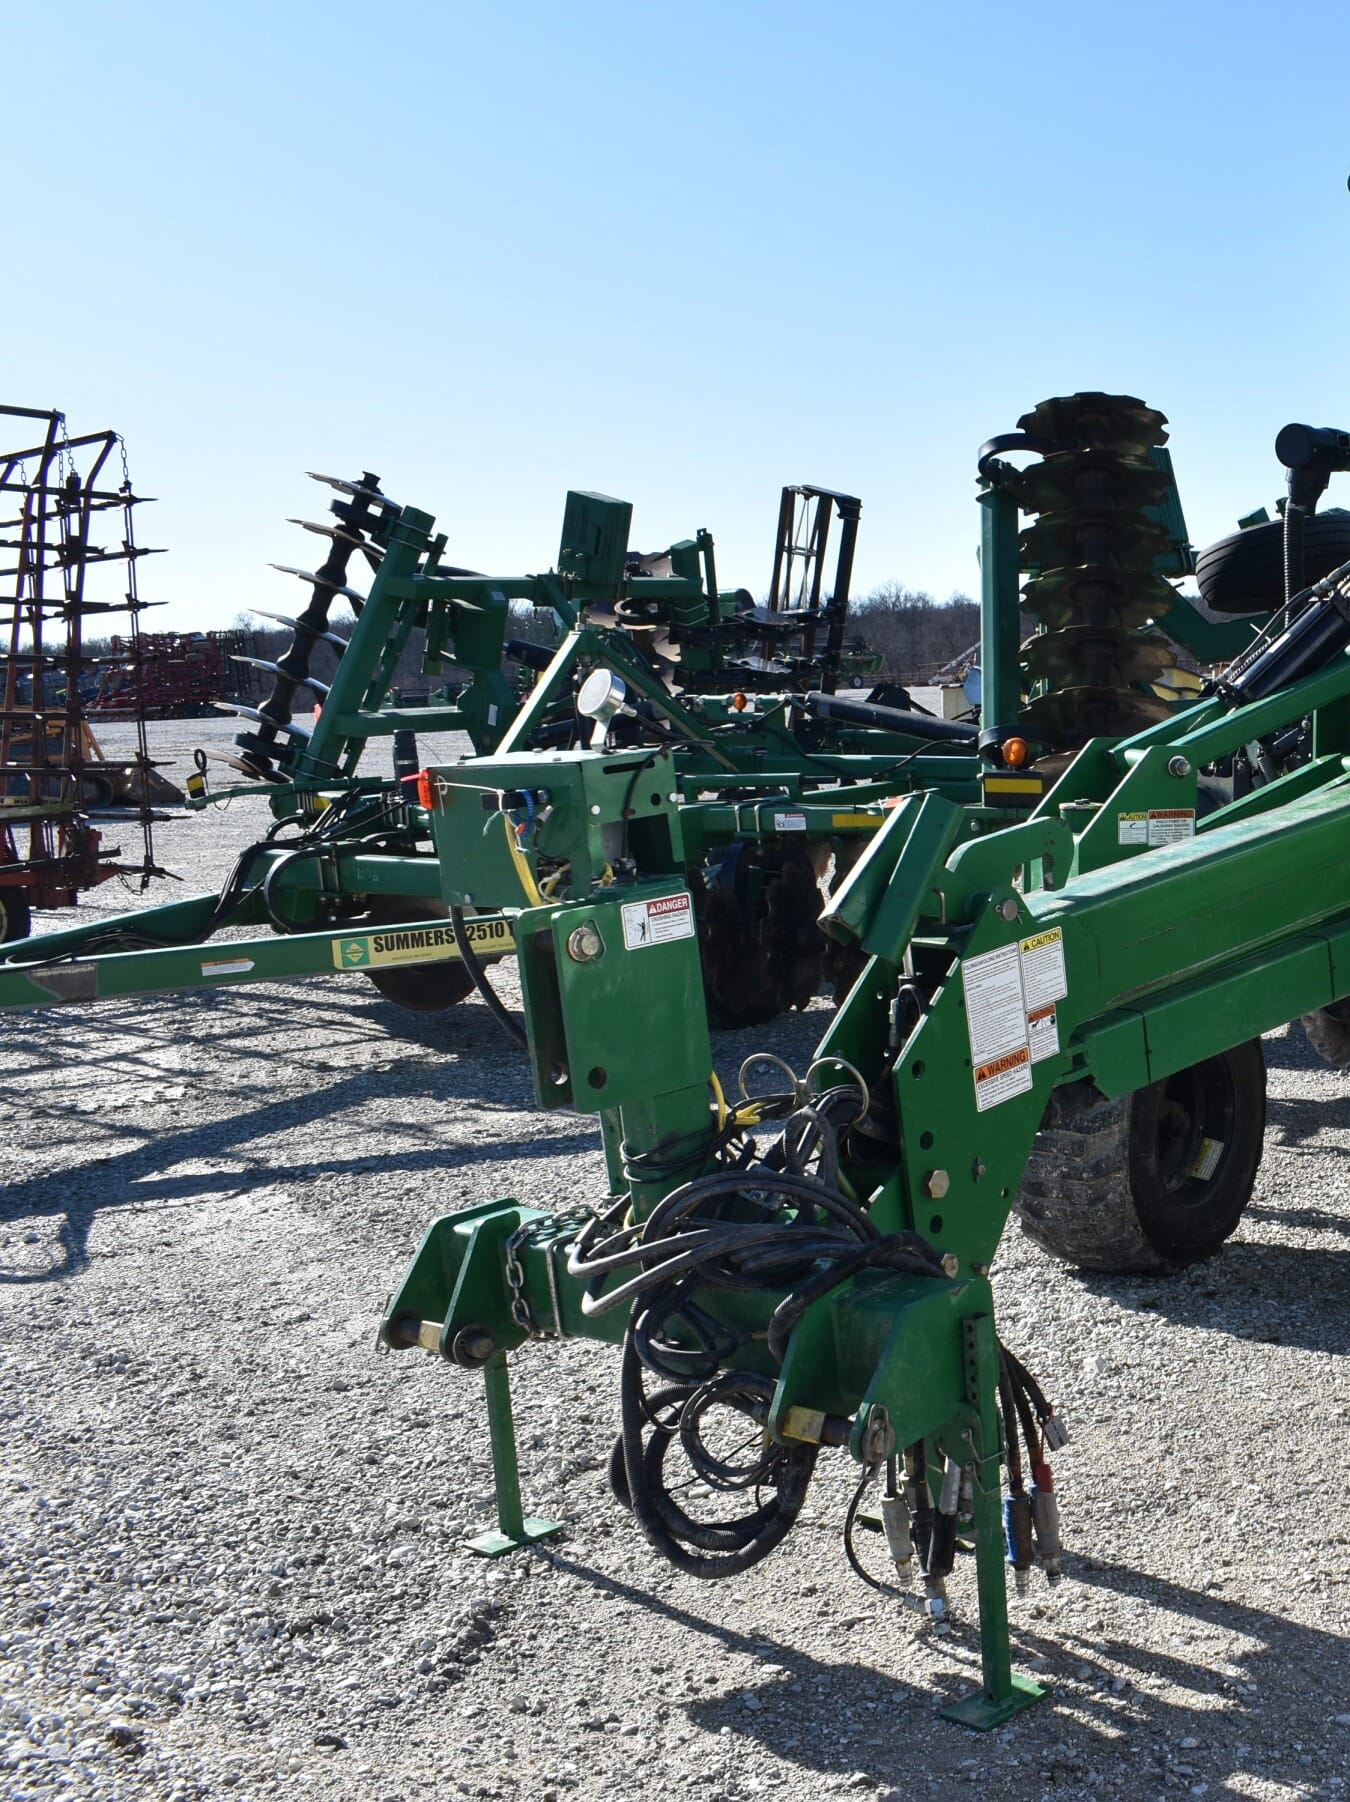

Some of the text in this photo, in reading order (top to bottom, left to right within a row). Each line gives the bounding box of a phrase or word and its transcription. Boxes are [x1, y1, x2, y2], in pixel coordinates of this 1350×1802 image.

[1157, 811, 1193, 819] WARNING
[656, 898, 688, 913] DANGER
[374, 928, 455, 953] SUMMERS
[467, 921, 505, 941] 2510
[1031, 932, 1060, 948] CAUTION
[987, 1050, 1026, 1074] WARNING
[978, 1064, 1029, 1089] EXCESSIVE SPEED HAZARD
